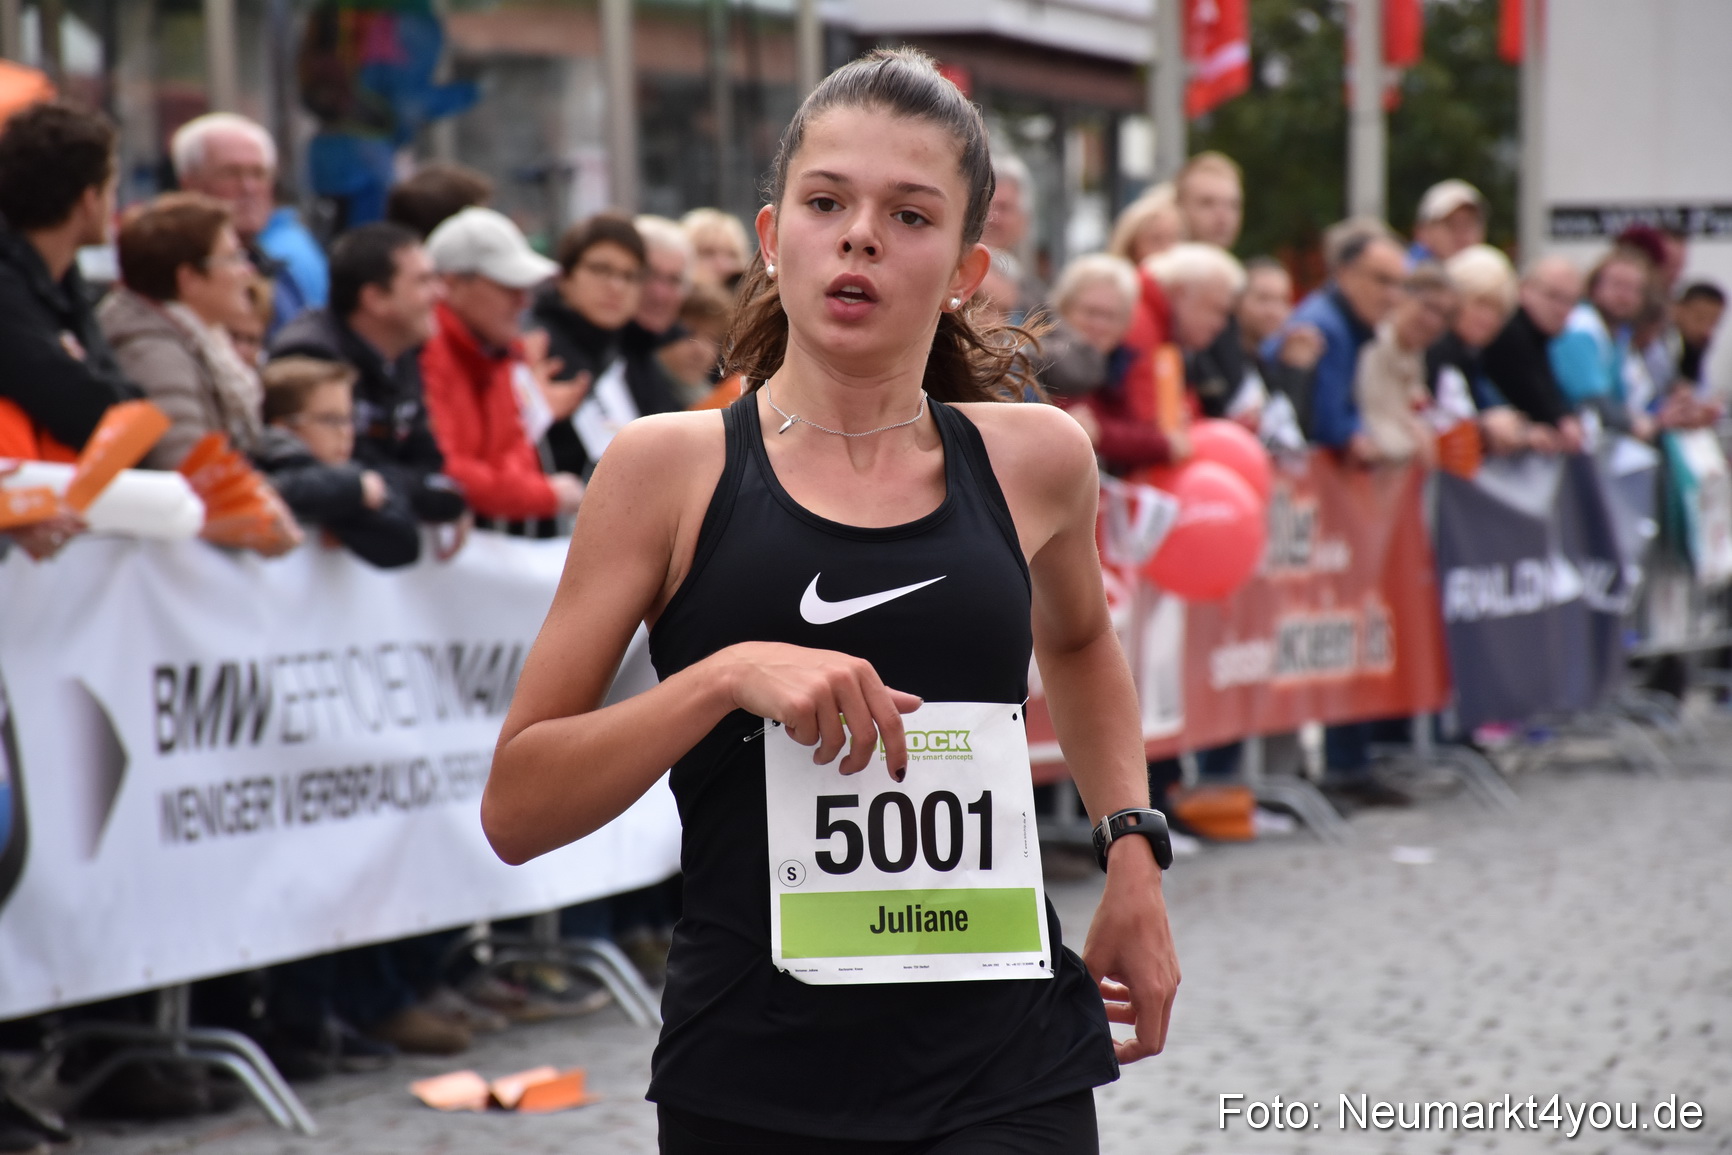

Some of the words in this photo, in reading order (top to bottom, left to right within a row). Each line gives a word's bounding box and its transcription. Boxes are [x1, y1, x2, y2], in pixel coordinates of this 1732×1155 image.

[153, 659, 273, 755] BMW
[879, 730, 972, 753] OCK
[911, 754, 921, 762] by
[944, 753, 974, 762] concepts
[814, 790, 993, 875] 5001
[786, 866, 798, 881] S
[869, 904, 969, 934] Juliane
